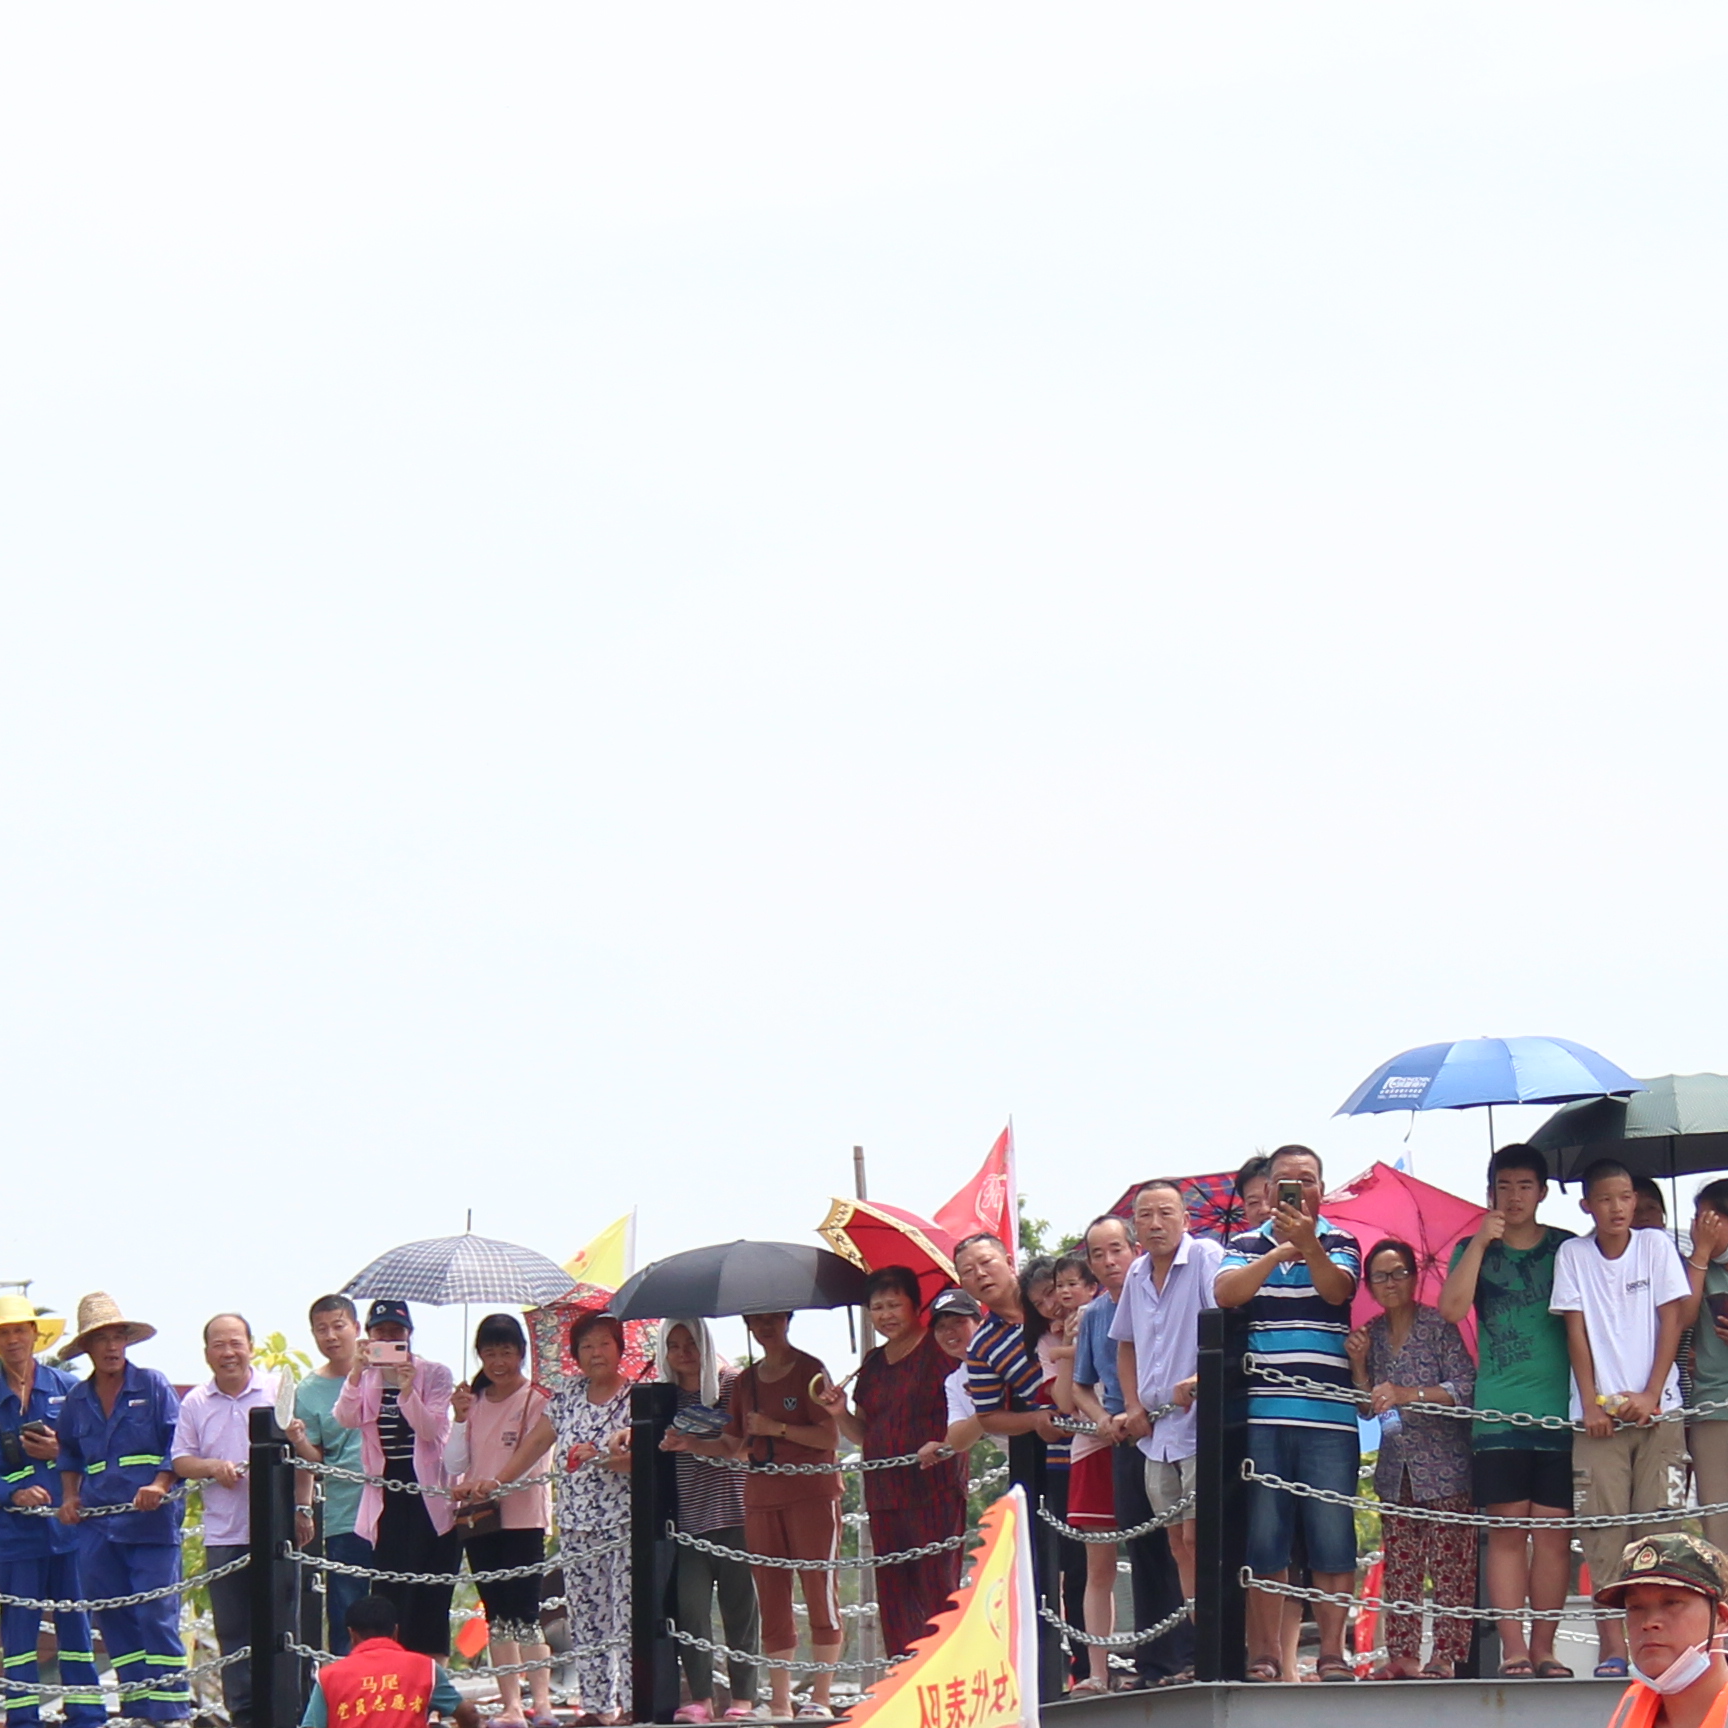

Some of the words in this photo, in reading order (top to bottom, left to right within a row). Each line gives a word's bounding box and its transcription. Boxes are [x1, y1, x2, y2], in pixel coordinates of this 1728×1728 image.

[360, 1673, 399, 1694] 马尾
[337, 1693, 424, 1720] 党员志愿者
